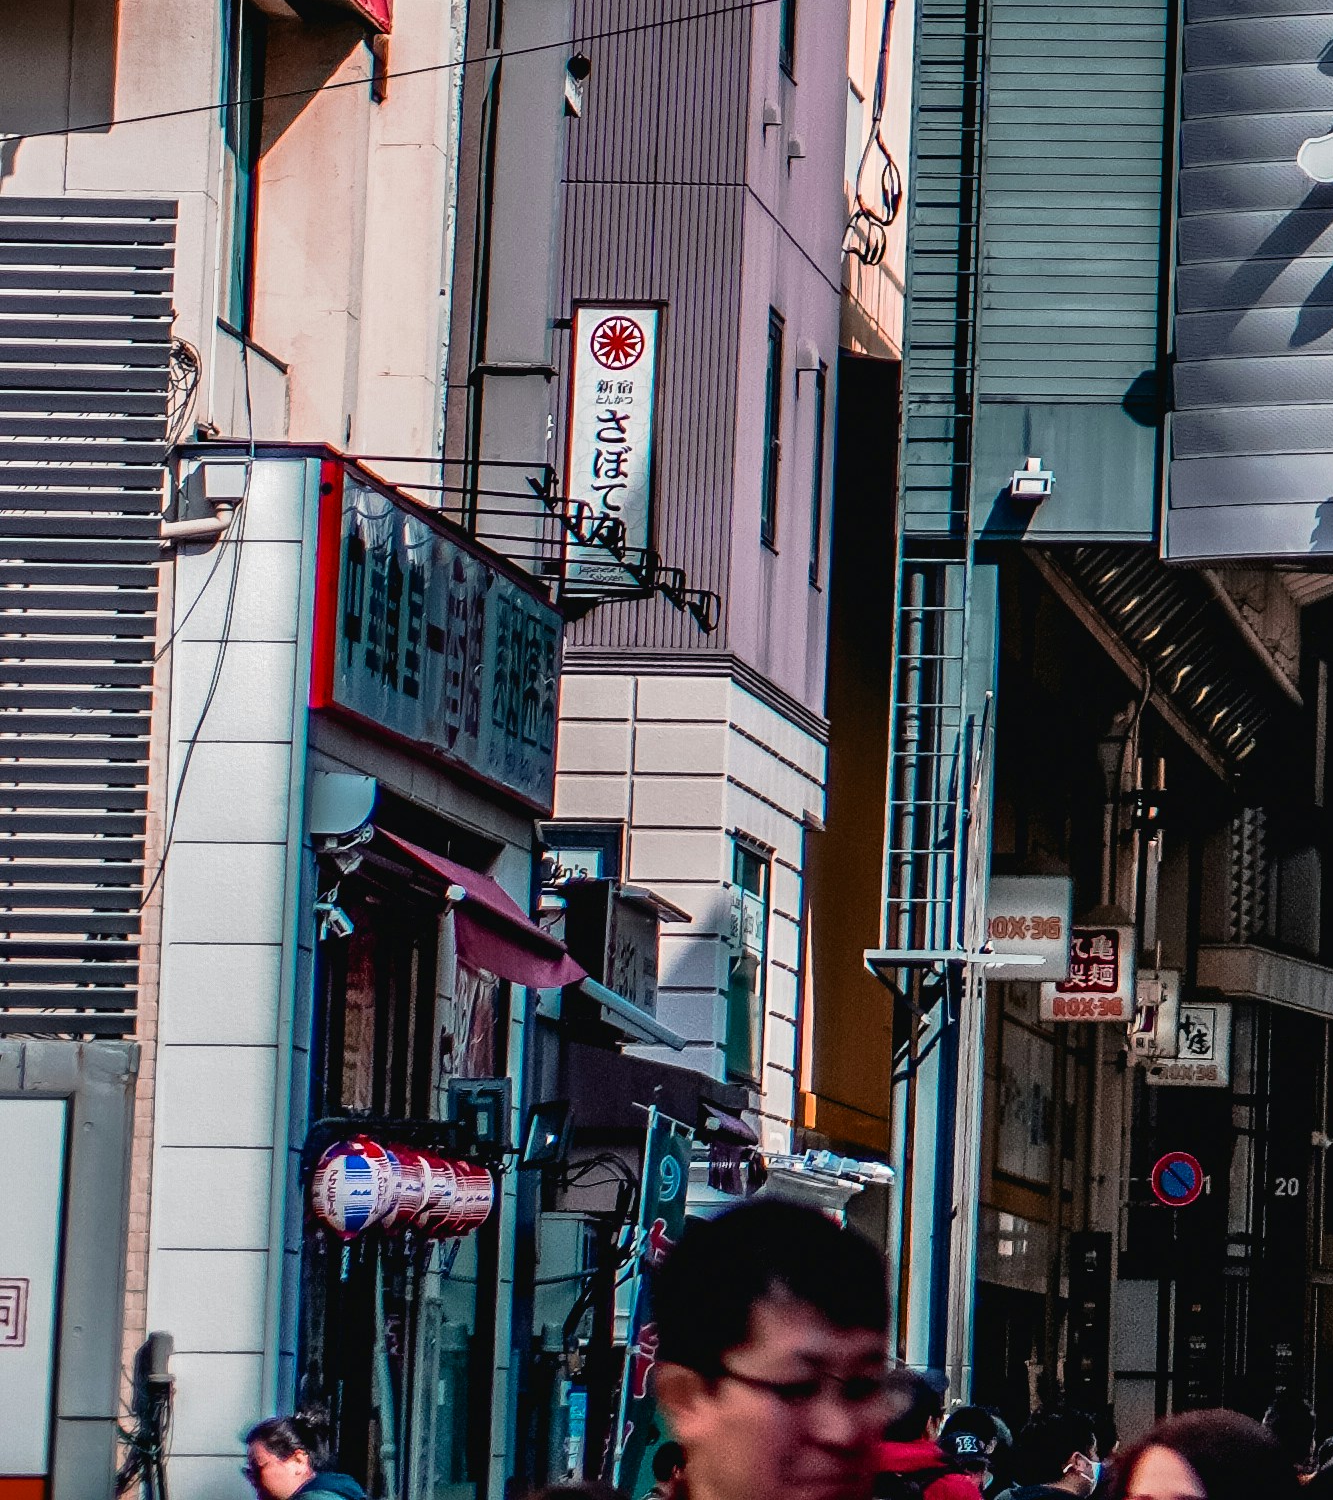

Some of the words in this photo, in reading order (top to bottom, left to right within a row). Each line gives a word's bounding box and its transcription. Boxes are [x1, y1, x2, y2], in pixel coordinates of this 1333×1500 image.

[597, 380, 634, 394] 新宿
[596, 395, 633, 405] とんかつ
[987, 915, 1062, 940] OX·3G
[1274, 1177, 1300, 1197] 20
